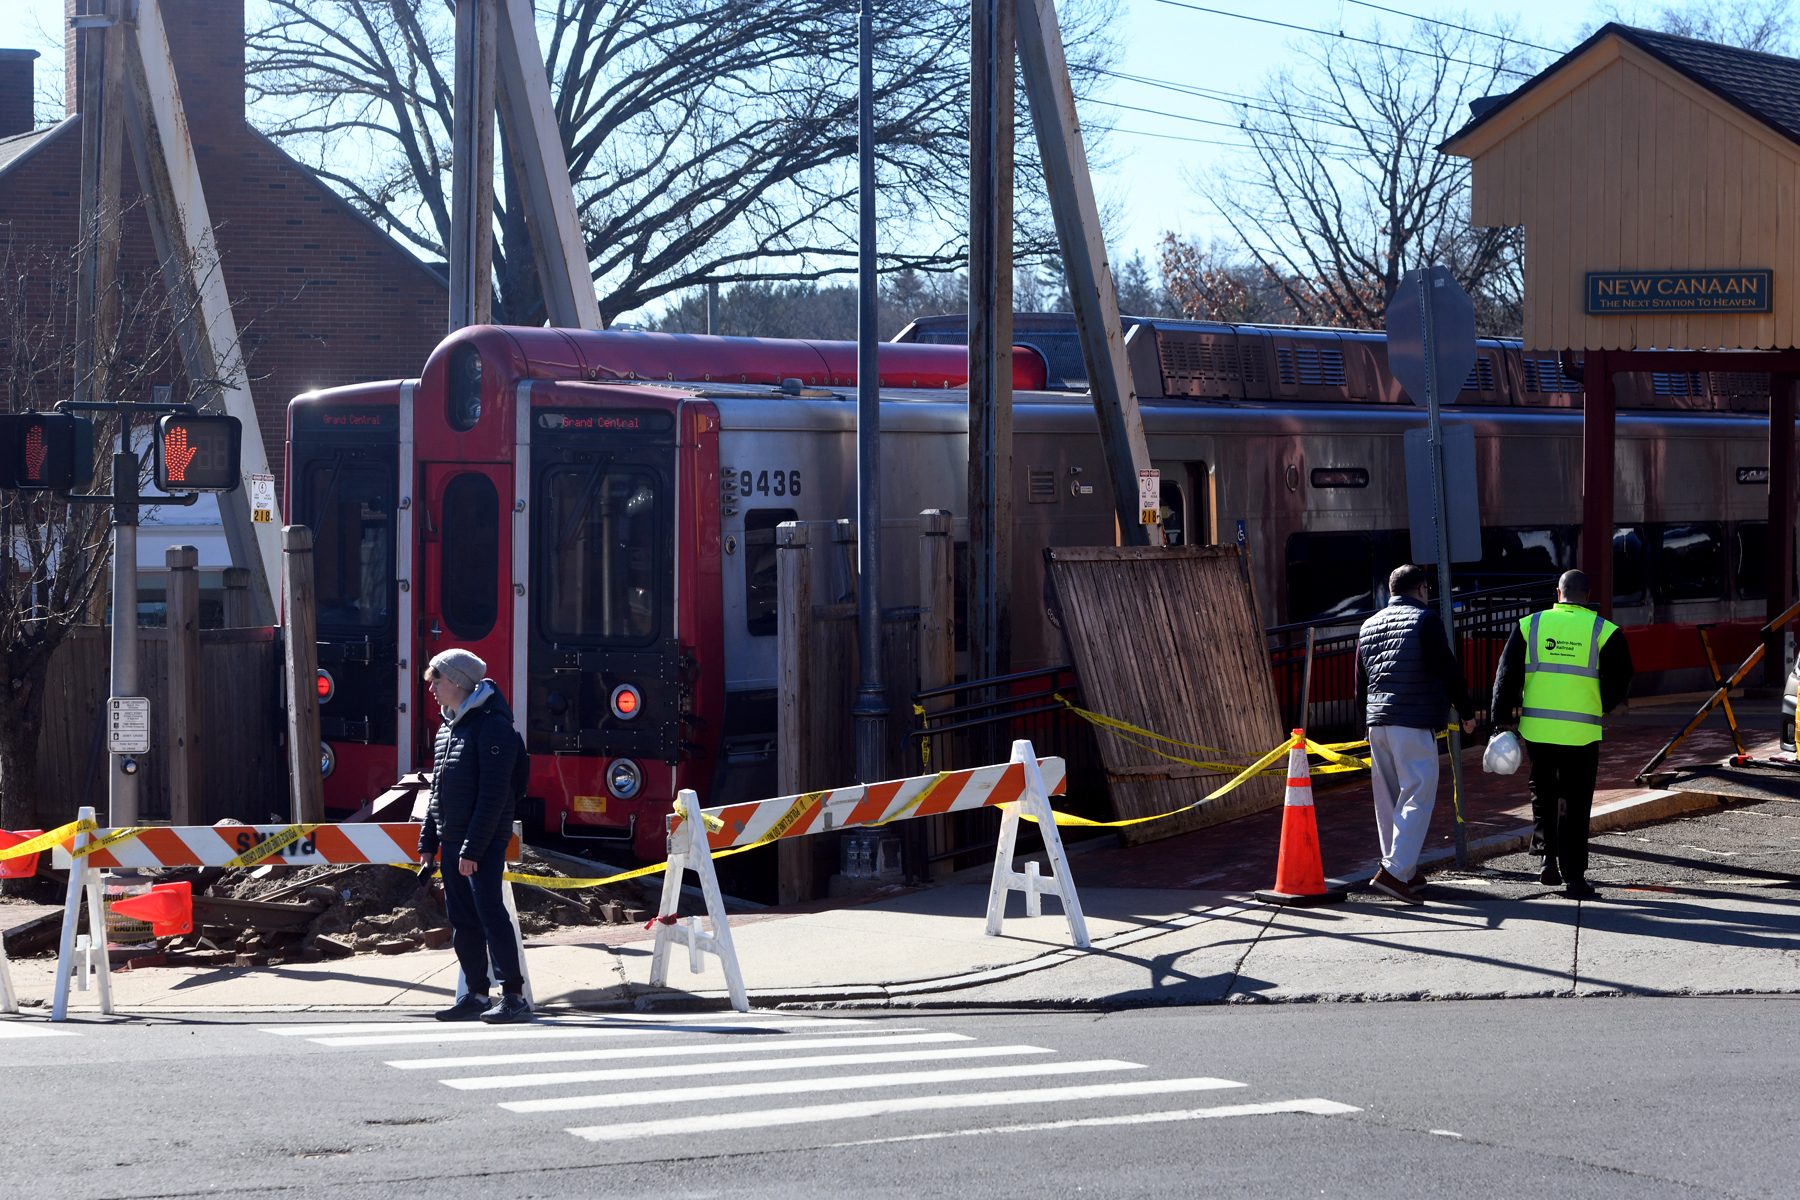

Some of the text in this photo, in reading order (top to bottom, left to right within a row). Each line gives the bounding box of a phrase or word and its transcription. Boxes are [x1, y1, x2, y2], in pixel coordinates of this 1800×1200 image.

[1598, 277, 1758, 295] NEW CANAAN
[324, 414, 380, 424] Grand Central
[562, 416, 639, 428] Grand Central
[740, 470, 801, 497] 9436
[254, 510, 270, 522] 218
[1142, 510, 1157, 522] 218
[786, 806, 800, 825] POLICE
[777, 818, 788, 832] LINE
[772, 827, 780, 838] DO
[240, 828, 297, 866] POLICE LINE DO NOT CROSS
